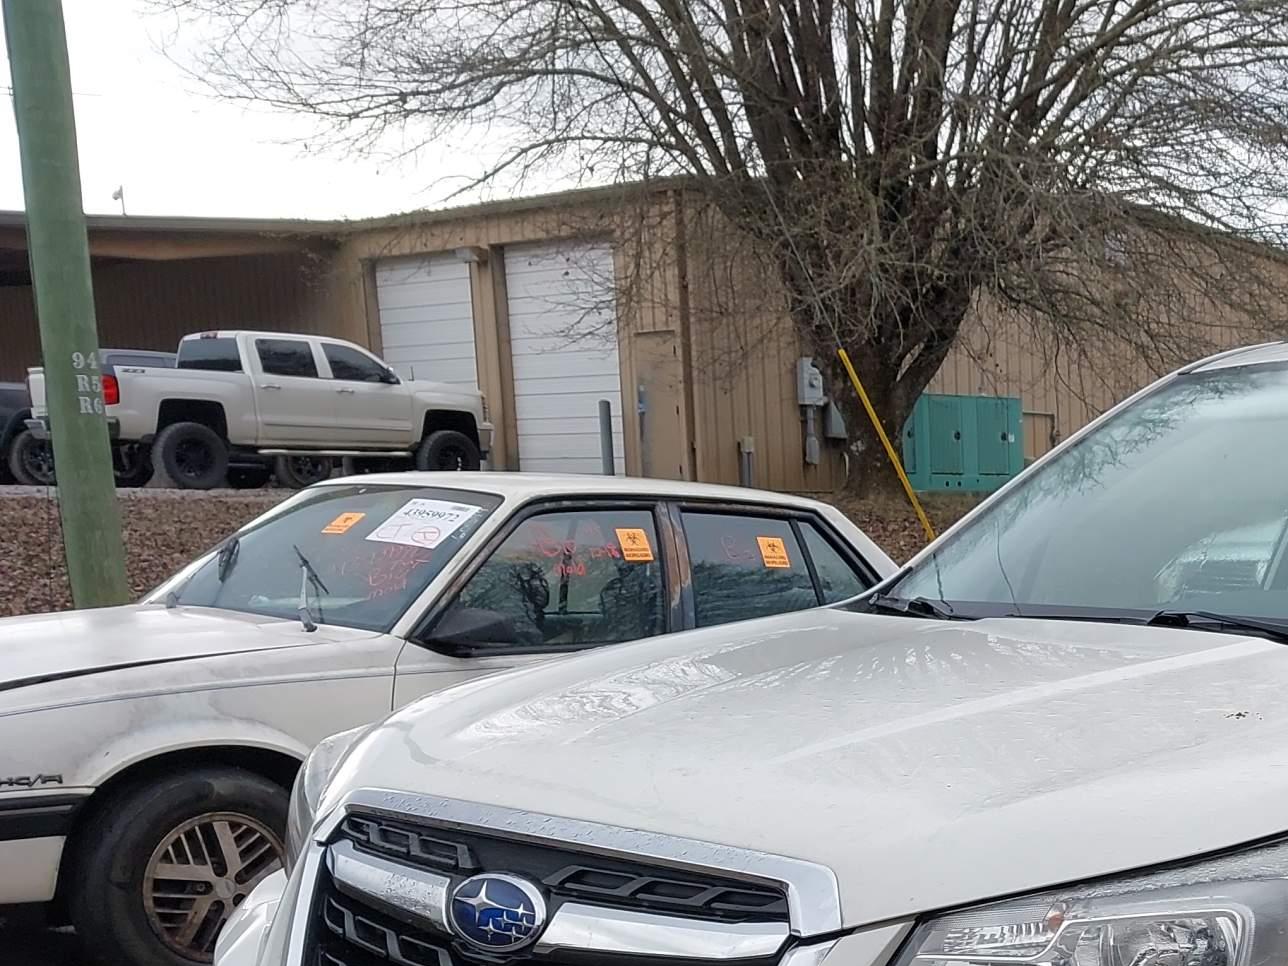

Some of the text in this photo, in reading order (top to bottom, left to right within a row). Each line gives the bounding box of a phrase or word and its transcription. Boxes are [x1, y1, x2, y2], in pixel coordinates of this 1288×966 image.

[71, 352, 98, 369] 94
[75, 374, 101, 393] R5
[78, 396, 104, 414] R6
